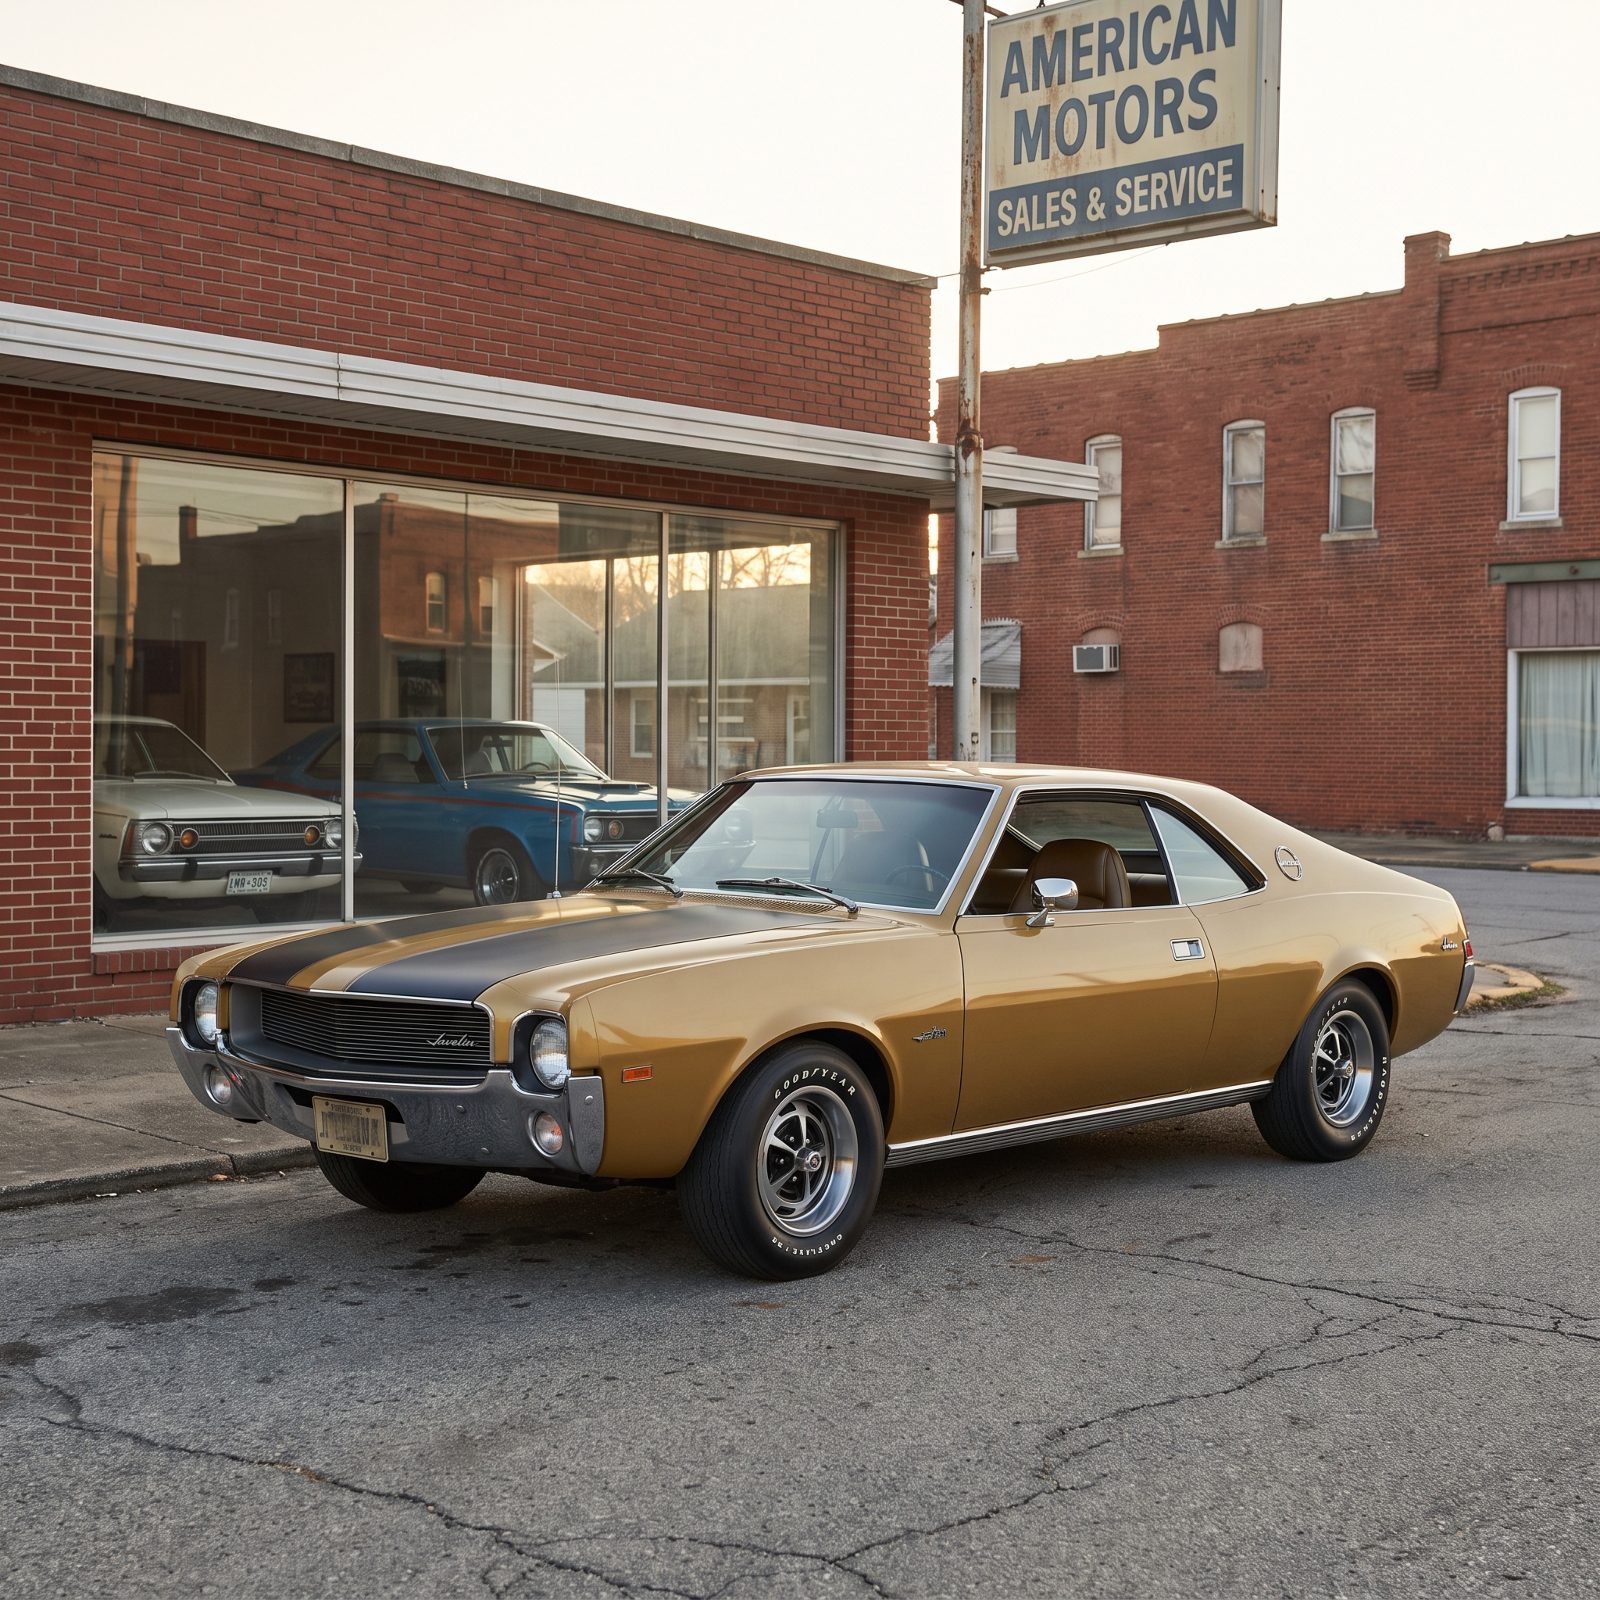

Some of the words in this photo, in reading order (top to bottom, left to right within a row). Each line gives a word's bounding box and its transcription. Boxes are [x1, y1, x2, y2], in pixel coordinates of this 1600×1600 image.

[1000, 0, 1237, 98] AMERICAN
[1013, 68, 1218, 166] MOTORS
[997, 188, 1077, 237] SALES
[1086, 188, 1106, 222] &
[1115, 158, 1233, 217] SERVICE
[426, 1032, 479, 1047] Javelin
[774, 1067, 856, 1099] GOODYEAR
